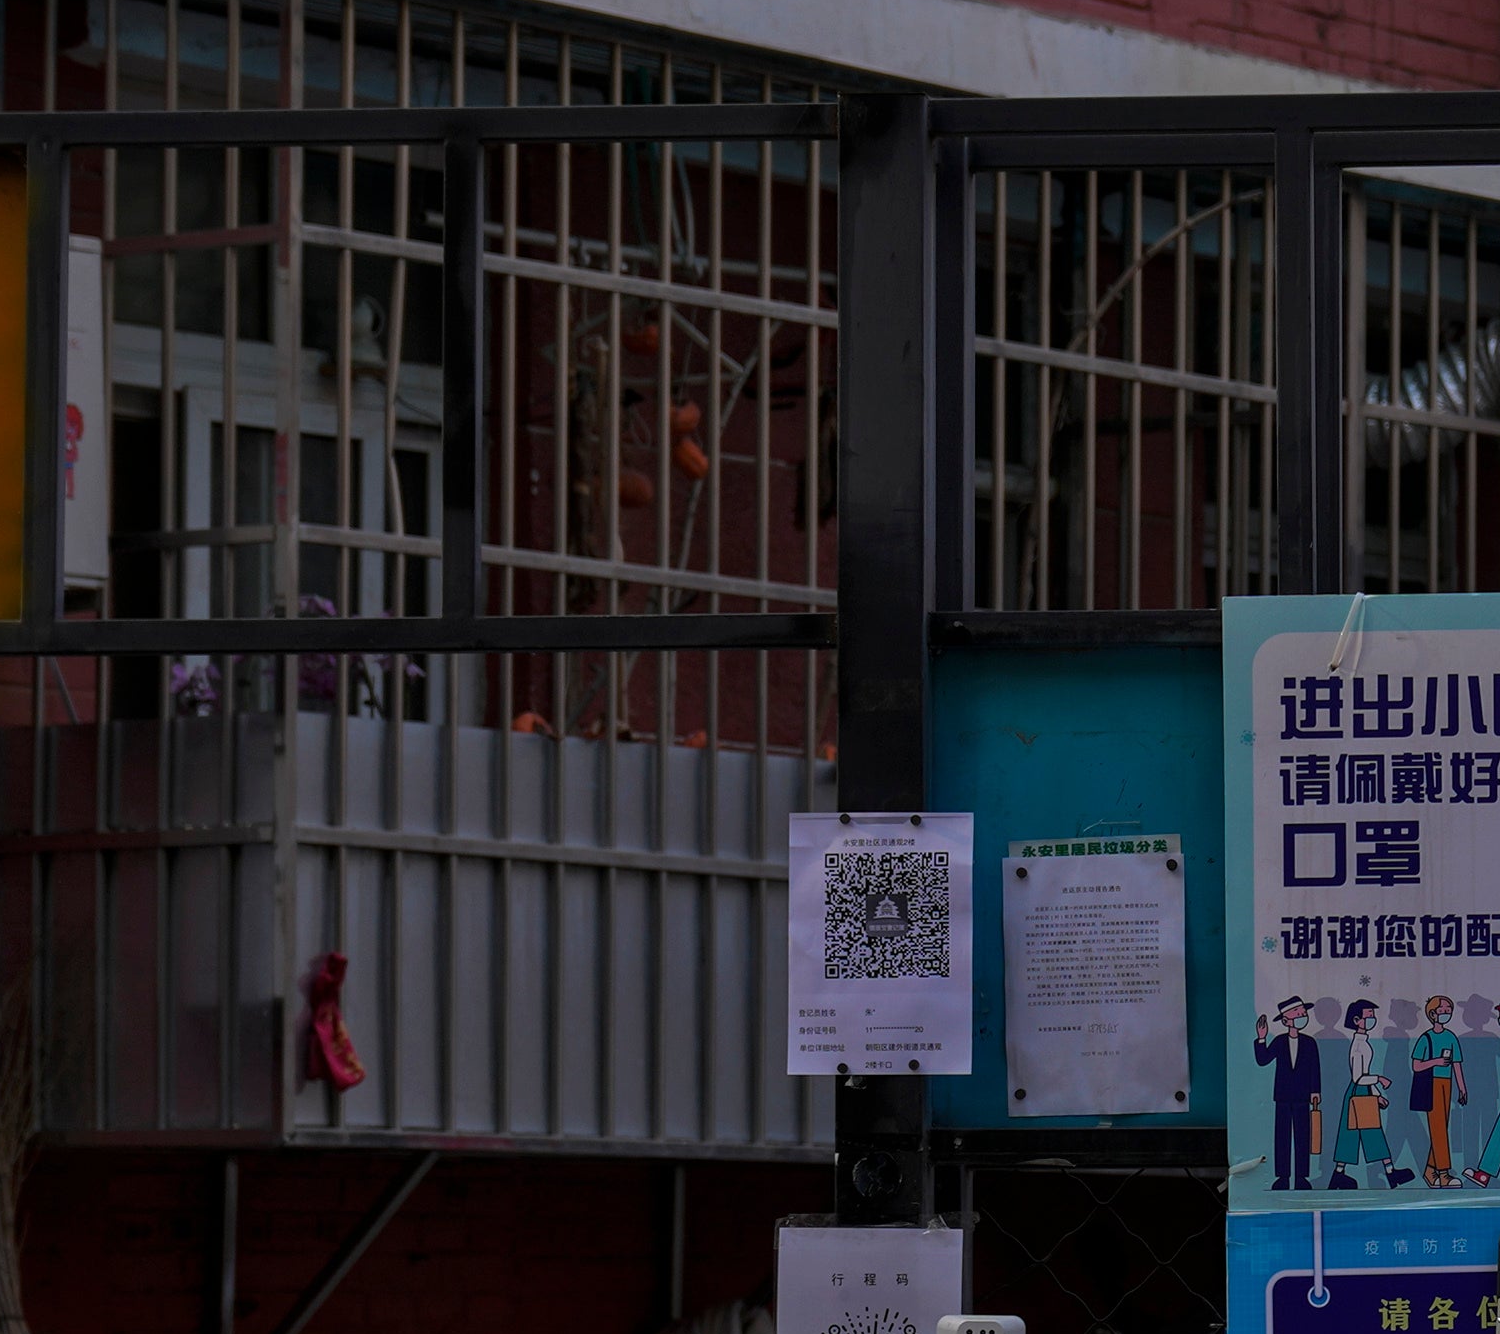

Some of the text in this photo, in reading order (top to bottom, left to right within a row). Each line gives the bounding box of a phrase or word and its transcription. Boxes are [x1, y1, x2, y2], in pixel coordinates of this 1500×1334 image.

[1280, 751, 1500, 806] 请佩戴好
[843, 838, 916, 847] 永安里社区灵通观2楼
[1022, 839, 1169, 858] 永安里居民垃圾分类
[1282, 820, 1422, 889] 口罩
[799, 1008, 836, 1017] 登记员姓名
[799, 1026, 837, 1035] 身份证号码
[800, 1042, 942, 1052] 单位详细地址 朝阳区建外街道灵通观
[1364, 1237, 1469, 1257] 疫情防控
[832, 1272, 910, 1288] 行程码
